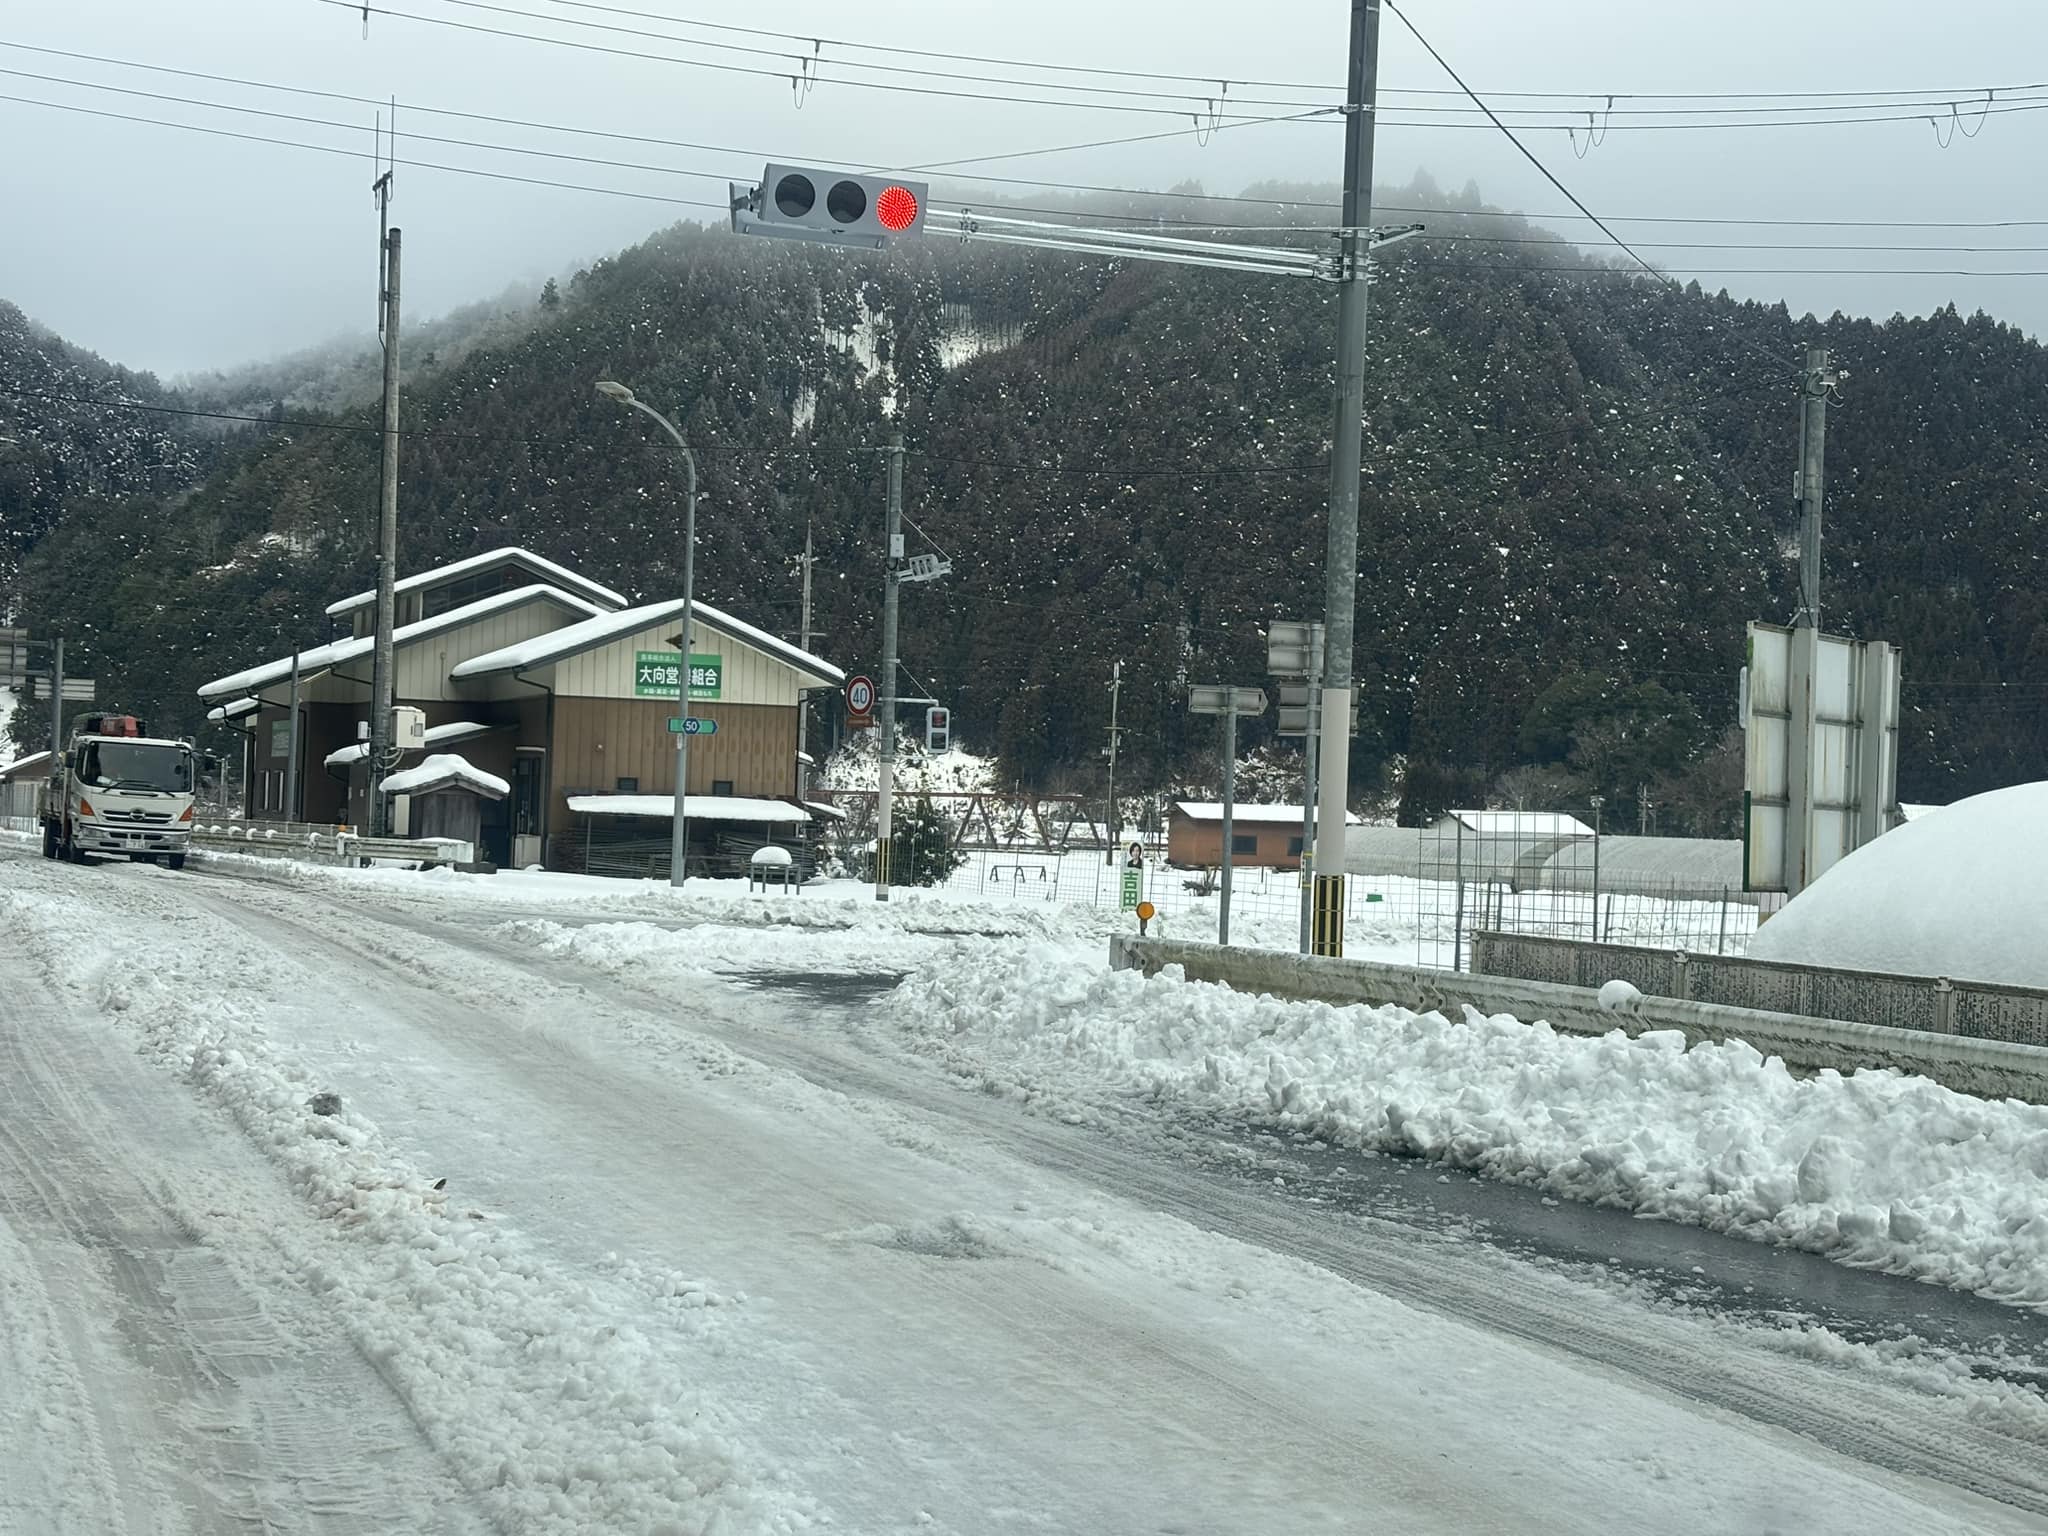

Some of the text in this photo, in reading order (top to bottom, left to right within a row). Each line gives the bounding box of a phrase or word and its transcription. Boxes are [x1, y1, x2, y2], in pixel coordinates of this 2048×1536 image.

[639, 665, 718, 686] 大向営組合
[853, 687, 868, 704] 40
[685, 721, 698, 731] 50
[1121, 870, 1138, 912] 吉田
